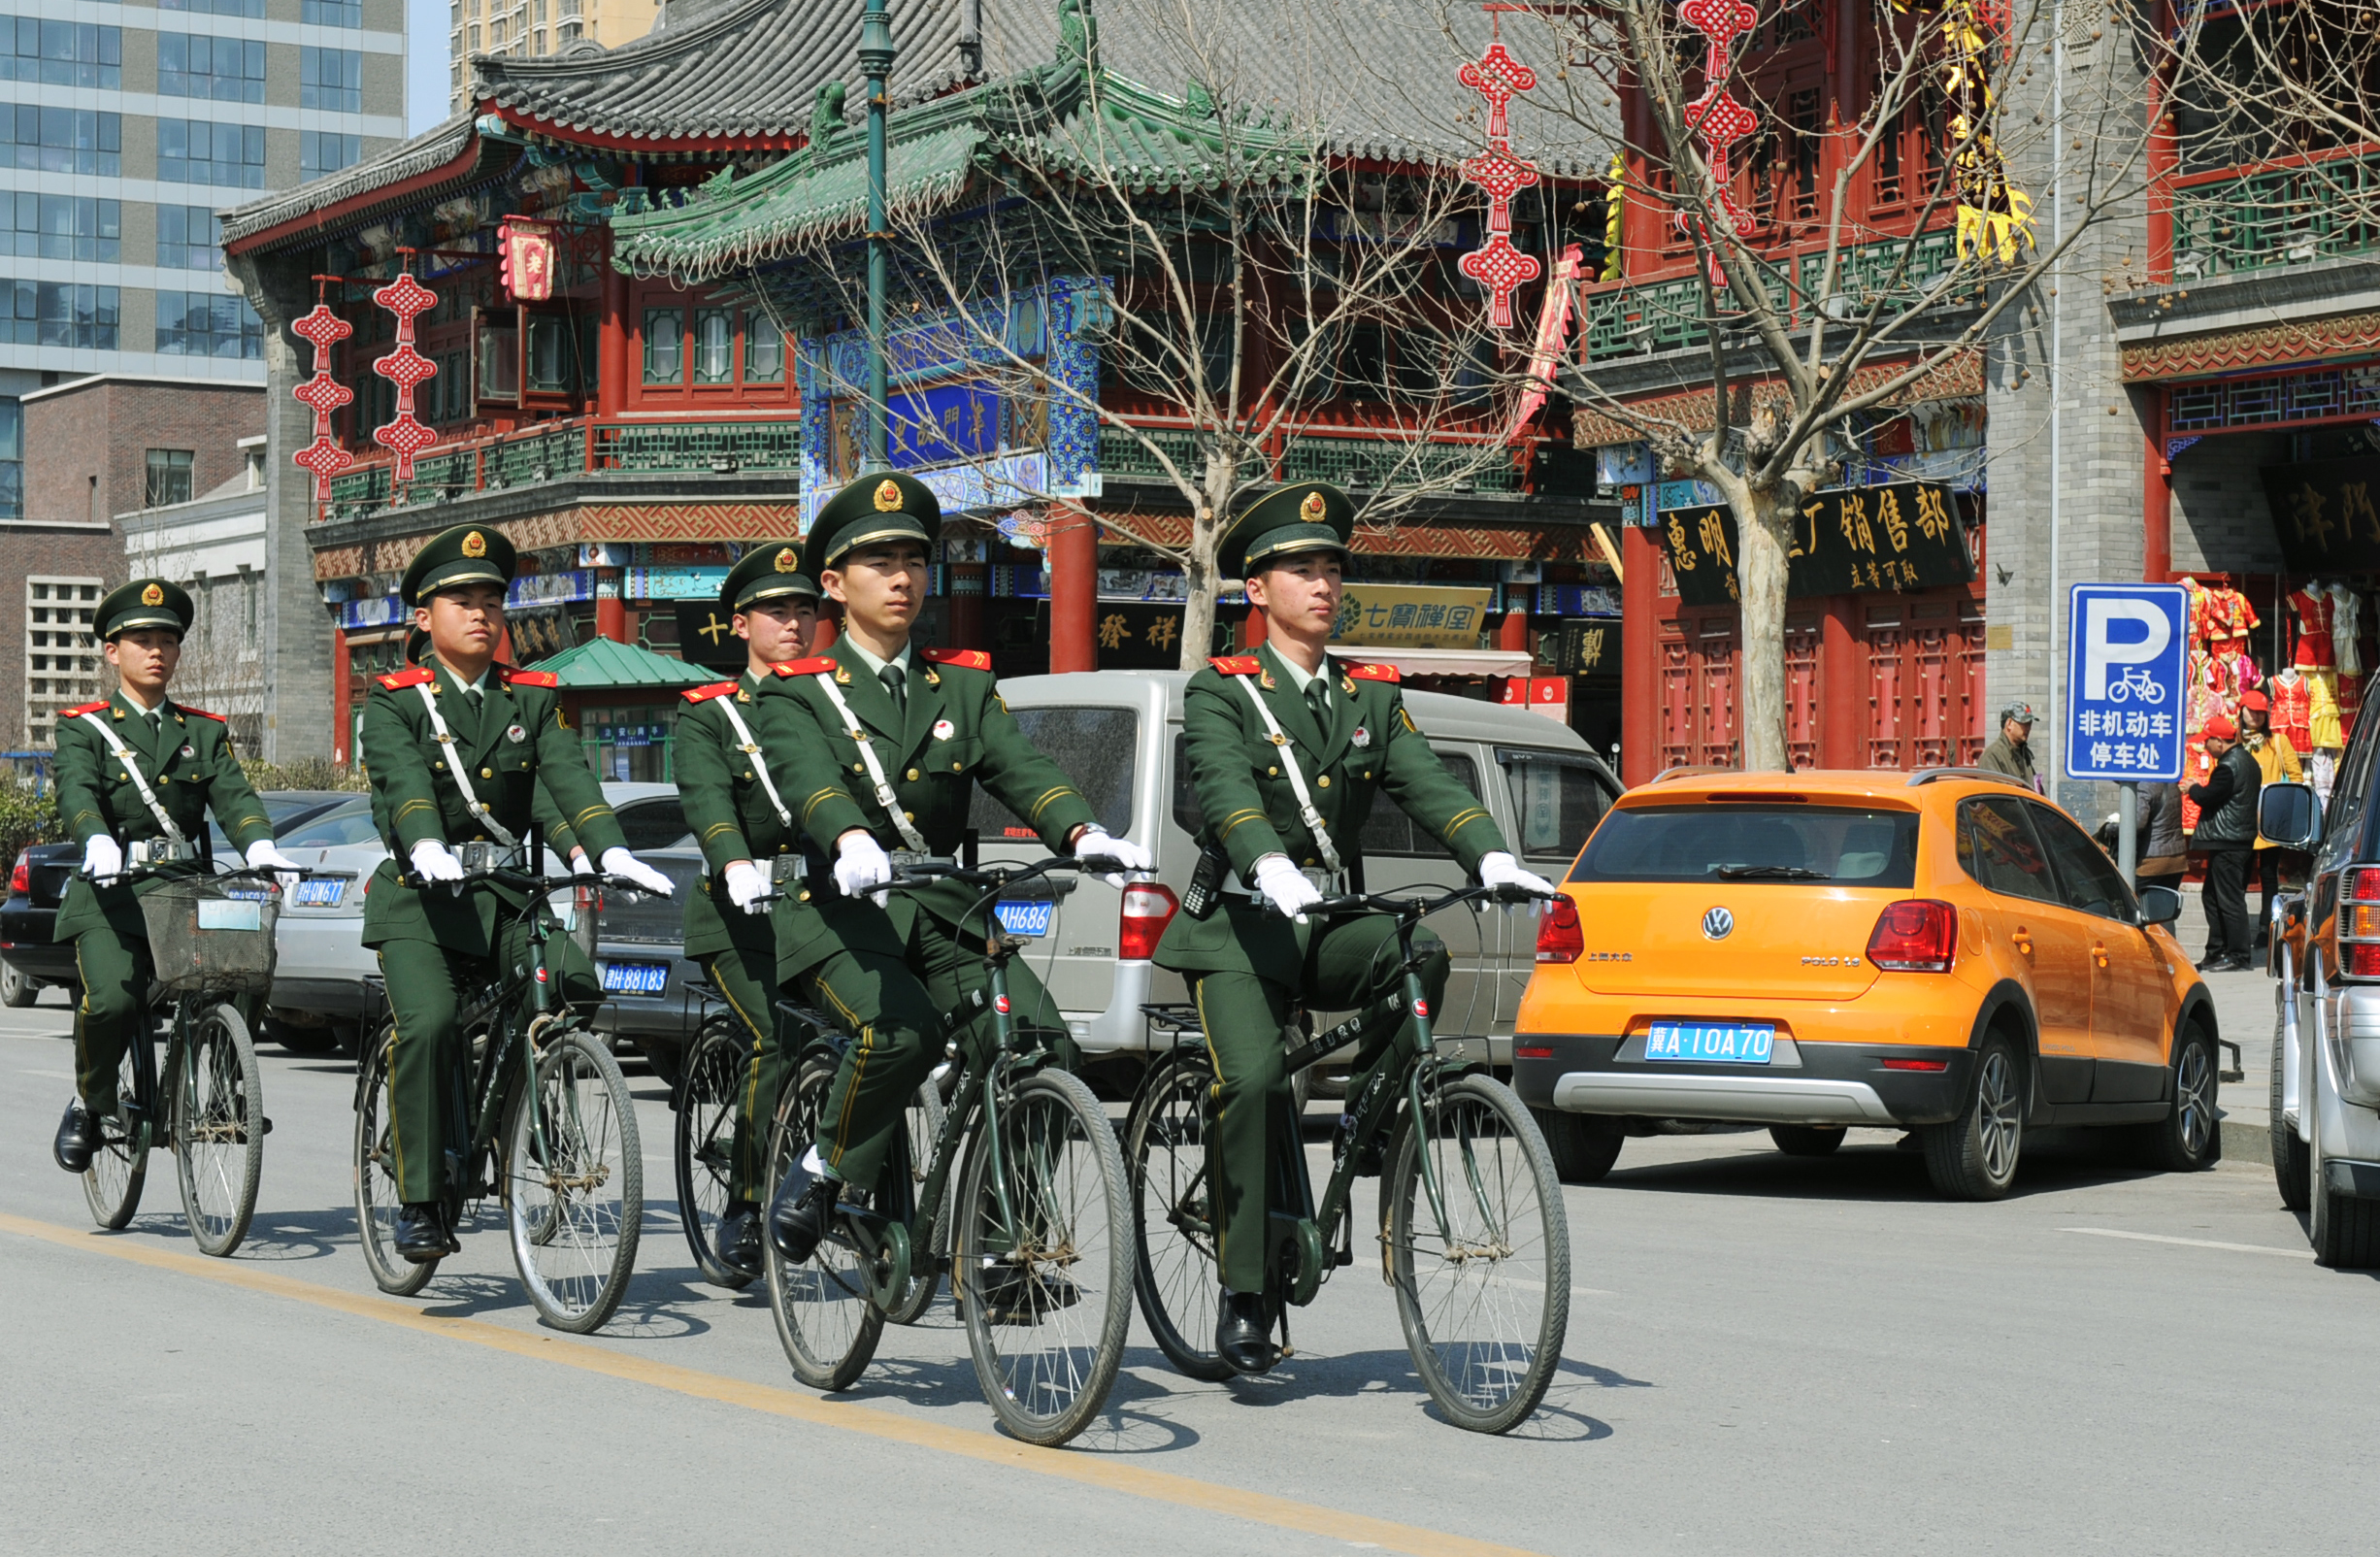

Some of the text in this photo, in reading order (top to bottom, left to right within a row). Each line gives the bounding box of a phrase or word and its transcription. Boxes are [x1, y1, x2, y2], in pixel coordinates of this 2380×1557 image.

[1849, 557, 1919, 589] 立等可取
[2085, 598, 2171, 701] P
[2078, 710, 2173, 739] 非机动车
[2090, 741, 2161, 770] 停车处
[1802, 956, 1838, 966] POLO
